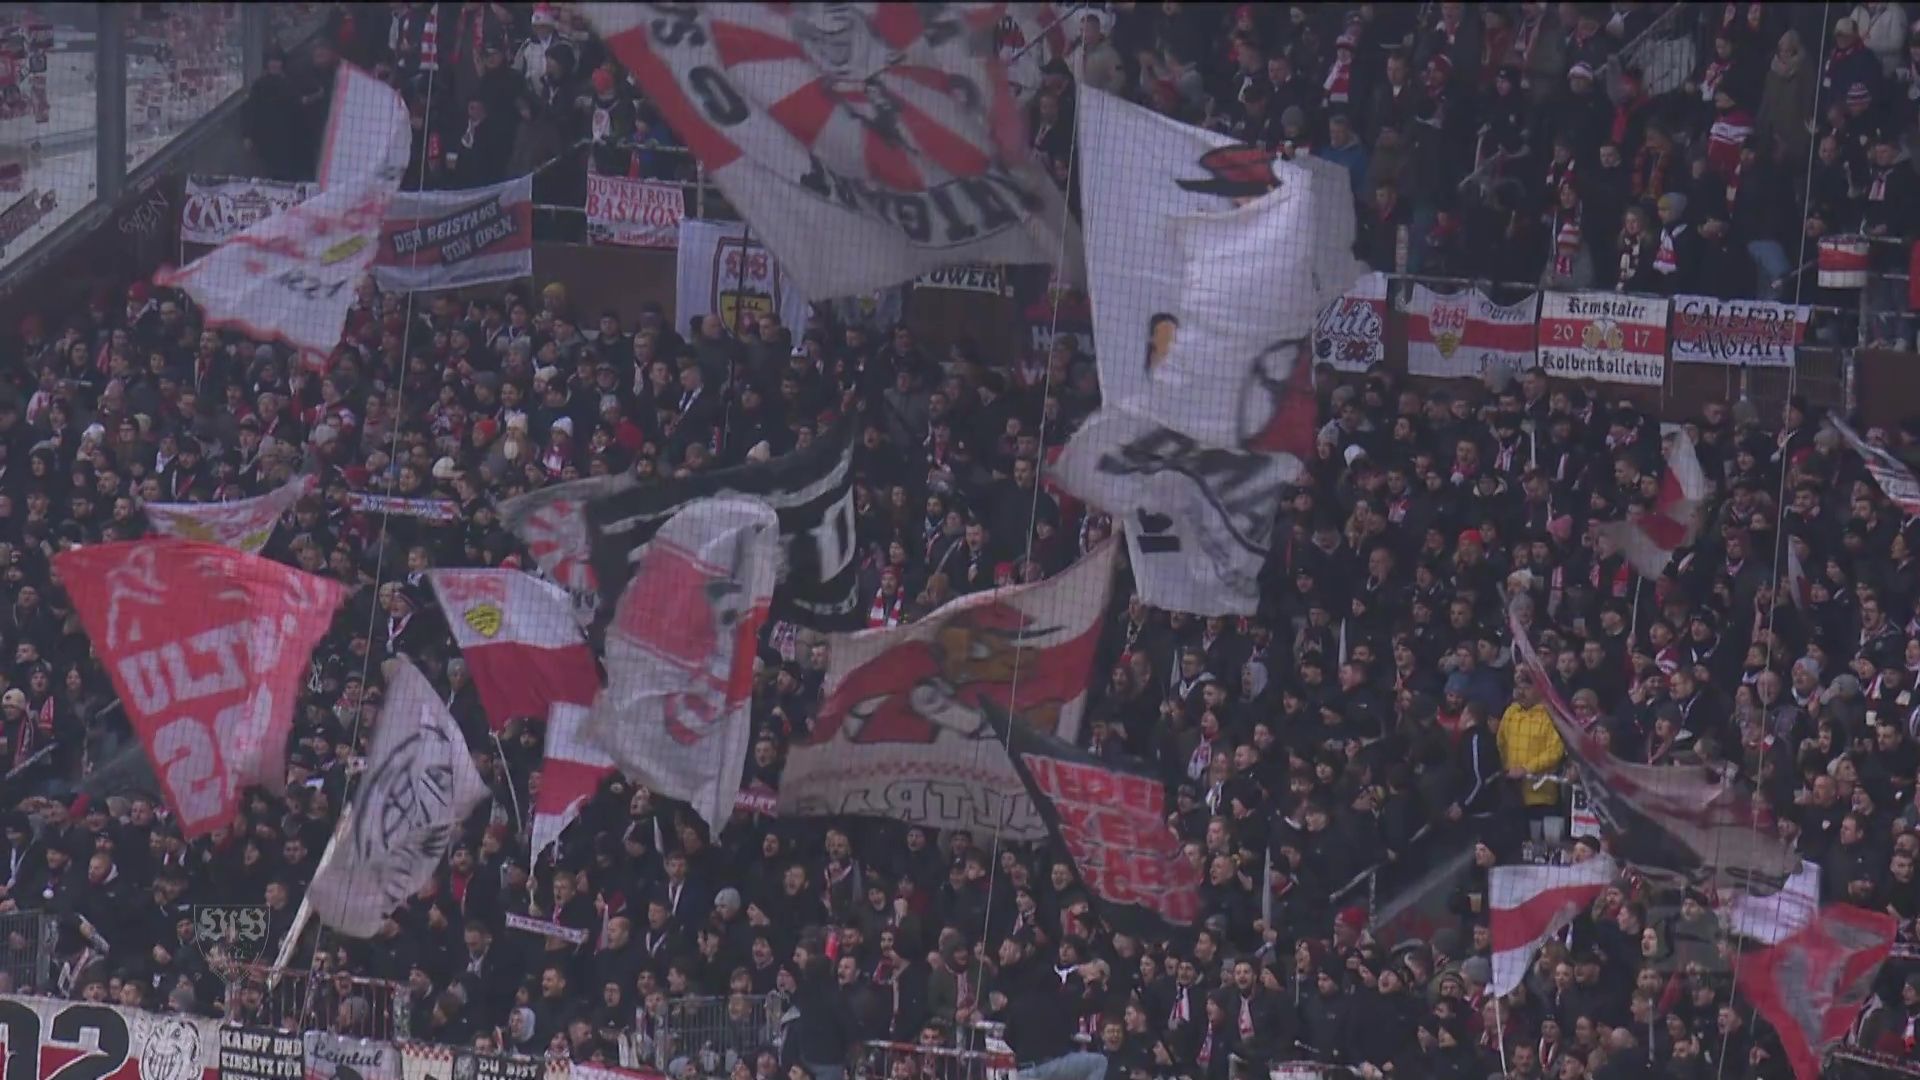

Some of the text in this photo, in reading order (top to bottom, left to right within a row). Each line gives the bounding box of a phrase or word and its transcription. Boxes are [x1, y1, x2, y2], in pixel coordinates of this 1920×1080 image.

[588, 194, 682, 228] BASTION
[1568, 296, 1646, 320] Remstaler
[1553, 324, 1650, 348] 20 17
[221, 1030, 303, 1055] KAMPF UND
[478, 1057, 500, 1074] DU
